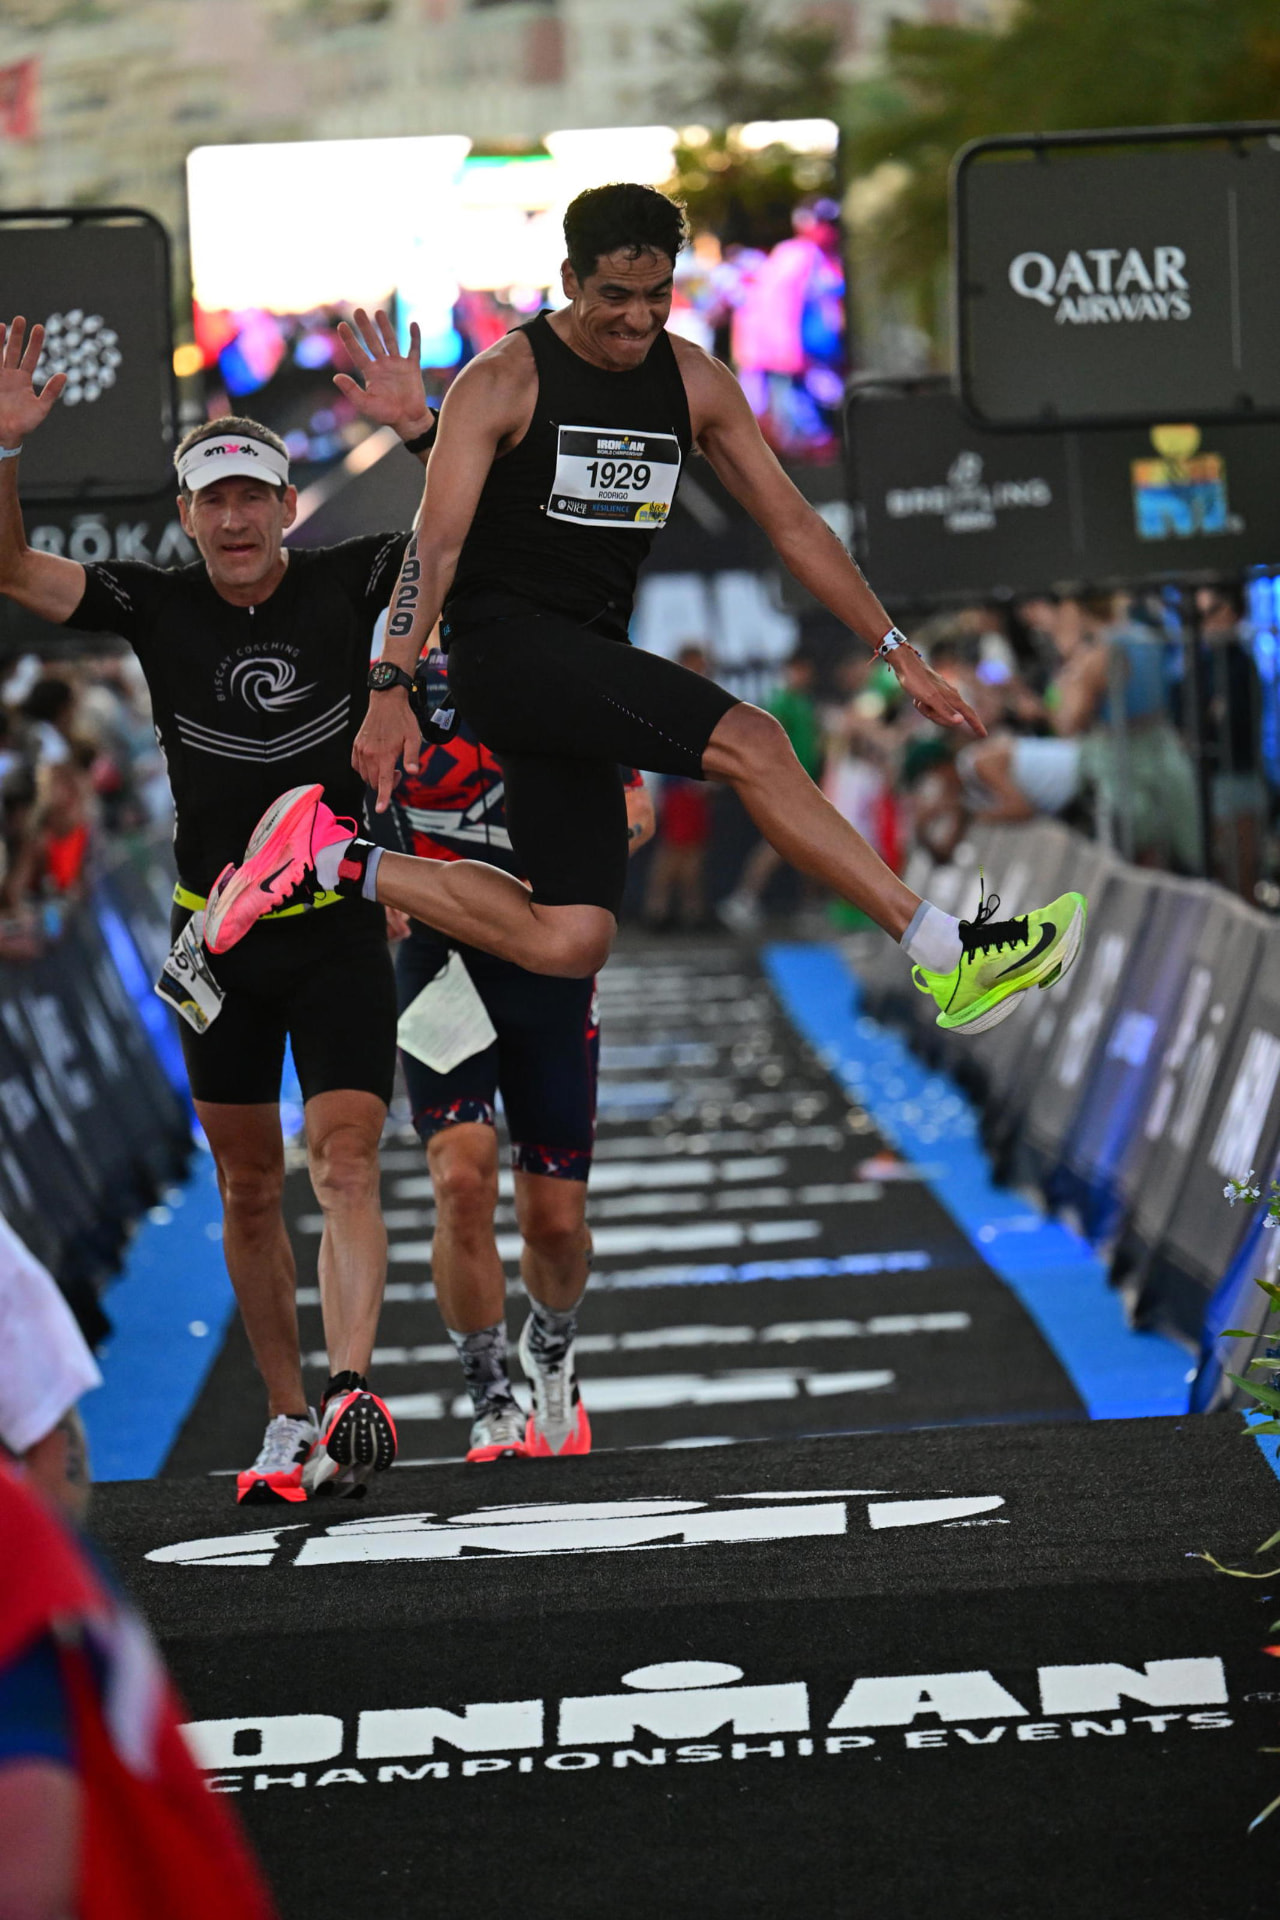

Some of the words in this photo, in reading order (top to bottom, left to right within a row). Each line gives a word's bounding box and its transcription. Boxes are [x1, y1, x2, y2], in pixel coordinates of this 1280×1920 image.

[1008, 246, 1189, 306] QATAR
[1054, 289, 1191, 324] AIRWAYS
[597, 437, 645, 451] IRONMAN
[587, 461, 651, 490] 1929
[566, 505, 587, 514] NICE
[598, 491, 628, 500] RODRIGO
[214, 656, 233, 701] BISCAY
[236, 642, 301, 658] COACHING
[204, 1735, 875, 1792] CHAMPIONSHIP
[905, 1711, 1235, 1750] EVENTS
